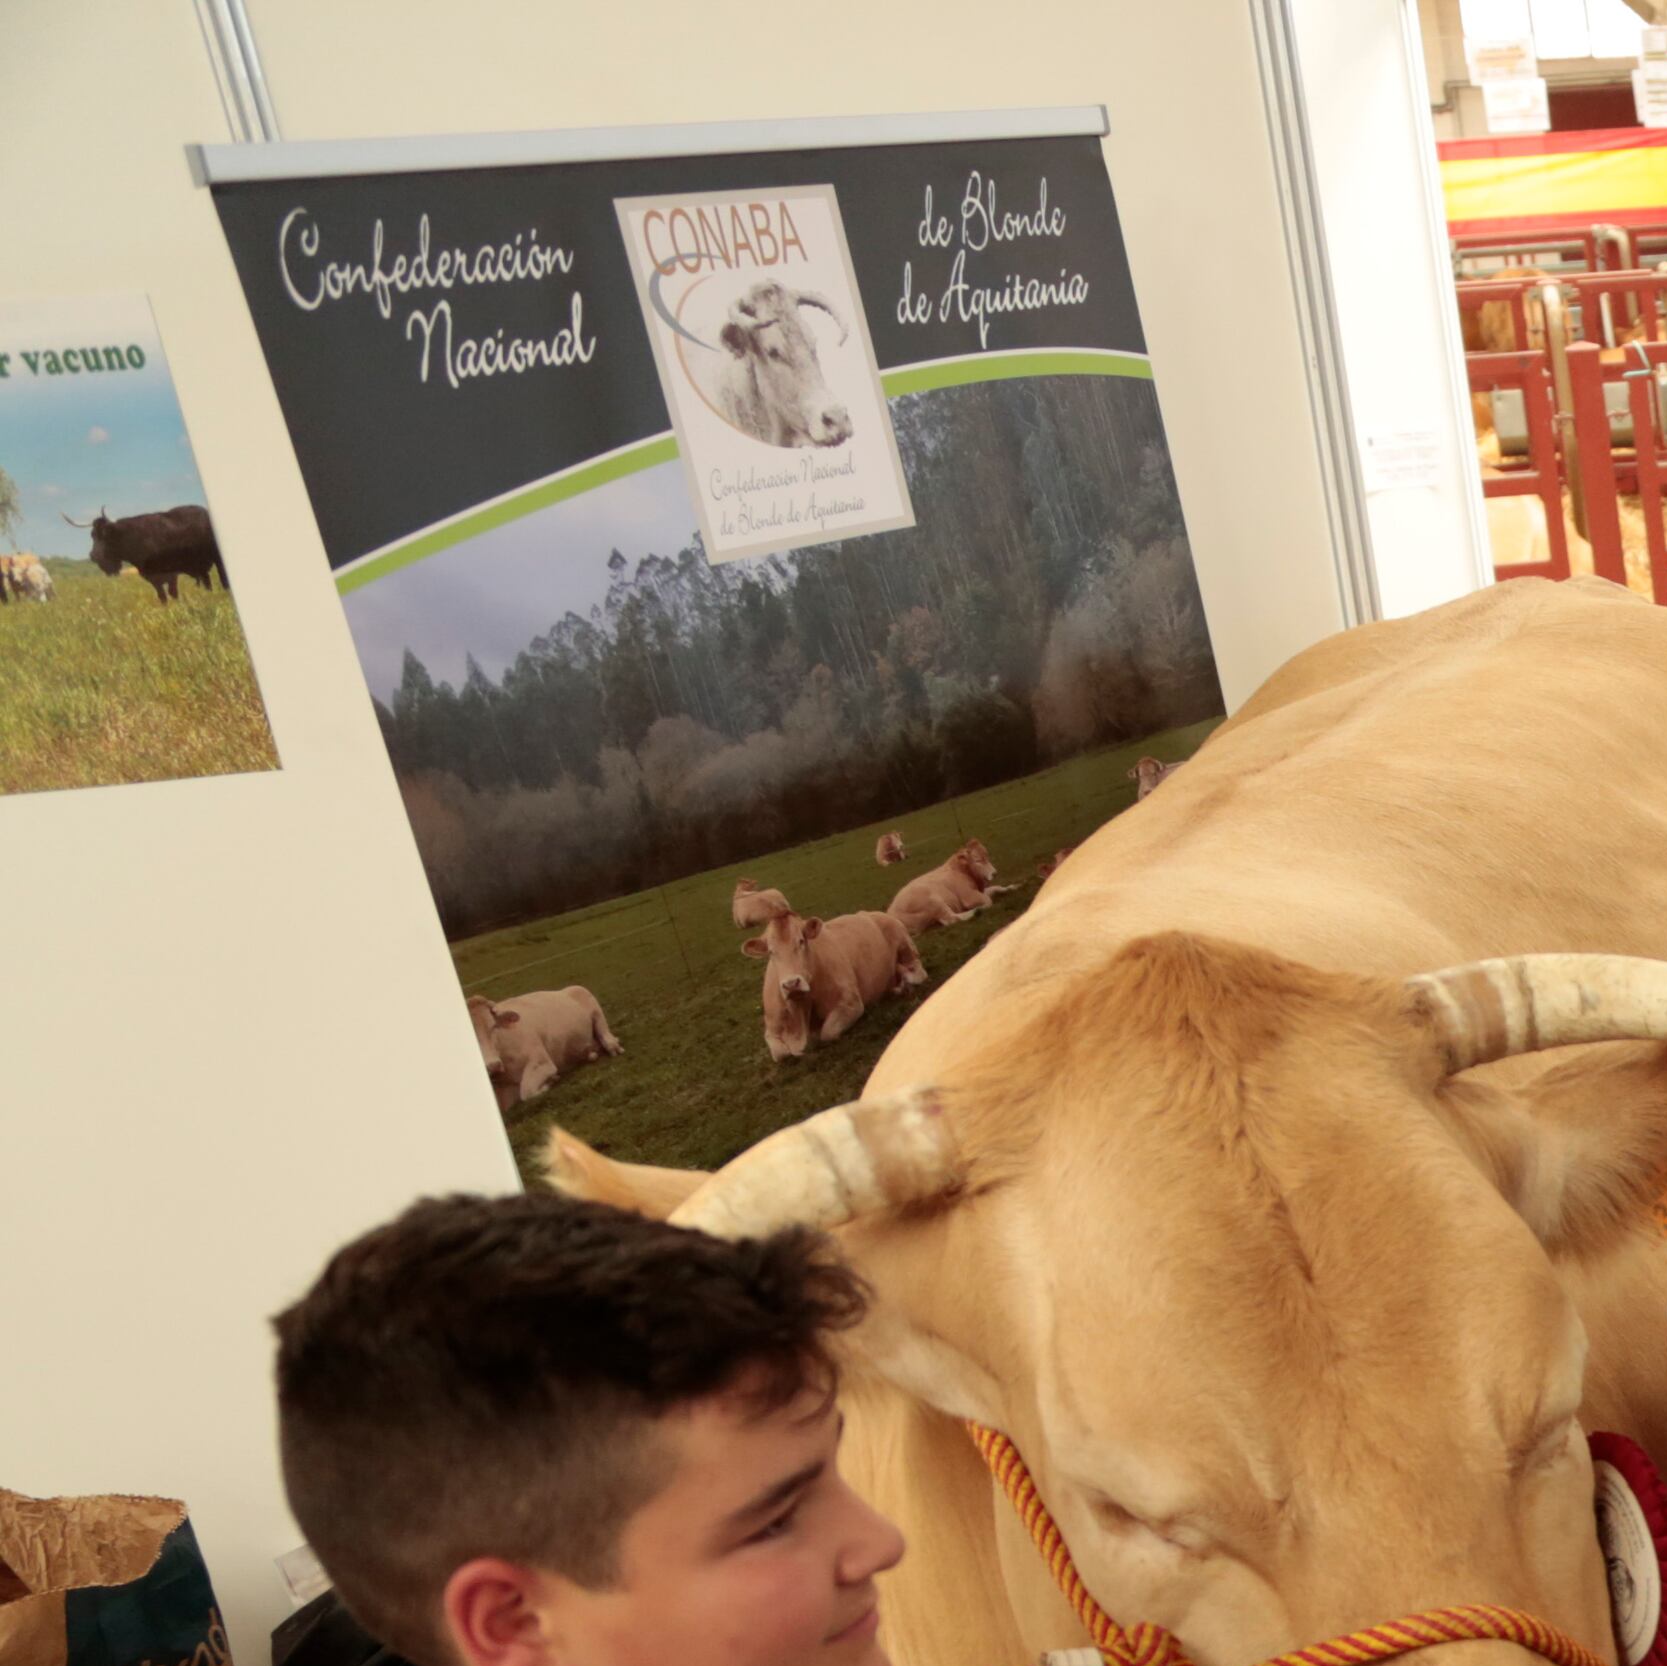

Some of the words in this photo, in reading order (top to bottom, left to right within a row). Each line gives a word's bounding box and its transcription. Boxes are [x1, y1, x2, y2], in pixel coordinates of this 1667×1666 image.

[643, 201, 809, 276] CONABA
[918, 184, 953, 247] de
[961, 170, 1066, 251] Blonde
[280, 206, 570, 319] Confederación
[897, 261, 932, 324] de
[939, 249, 1089, 349] Aquitania
[20, 344, 146, 376] vacuno
[406, 291, 596, 389] Nacional
[800, 450, 856, 483] Nacional
